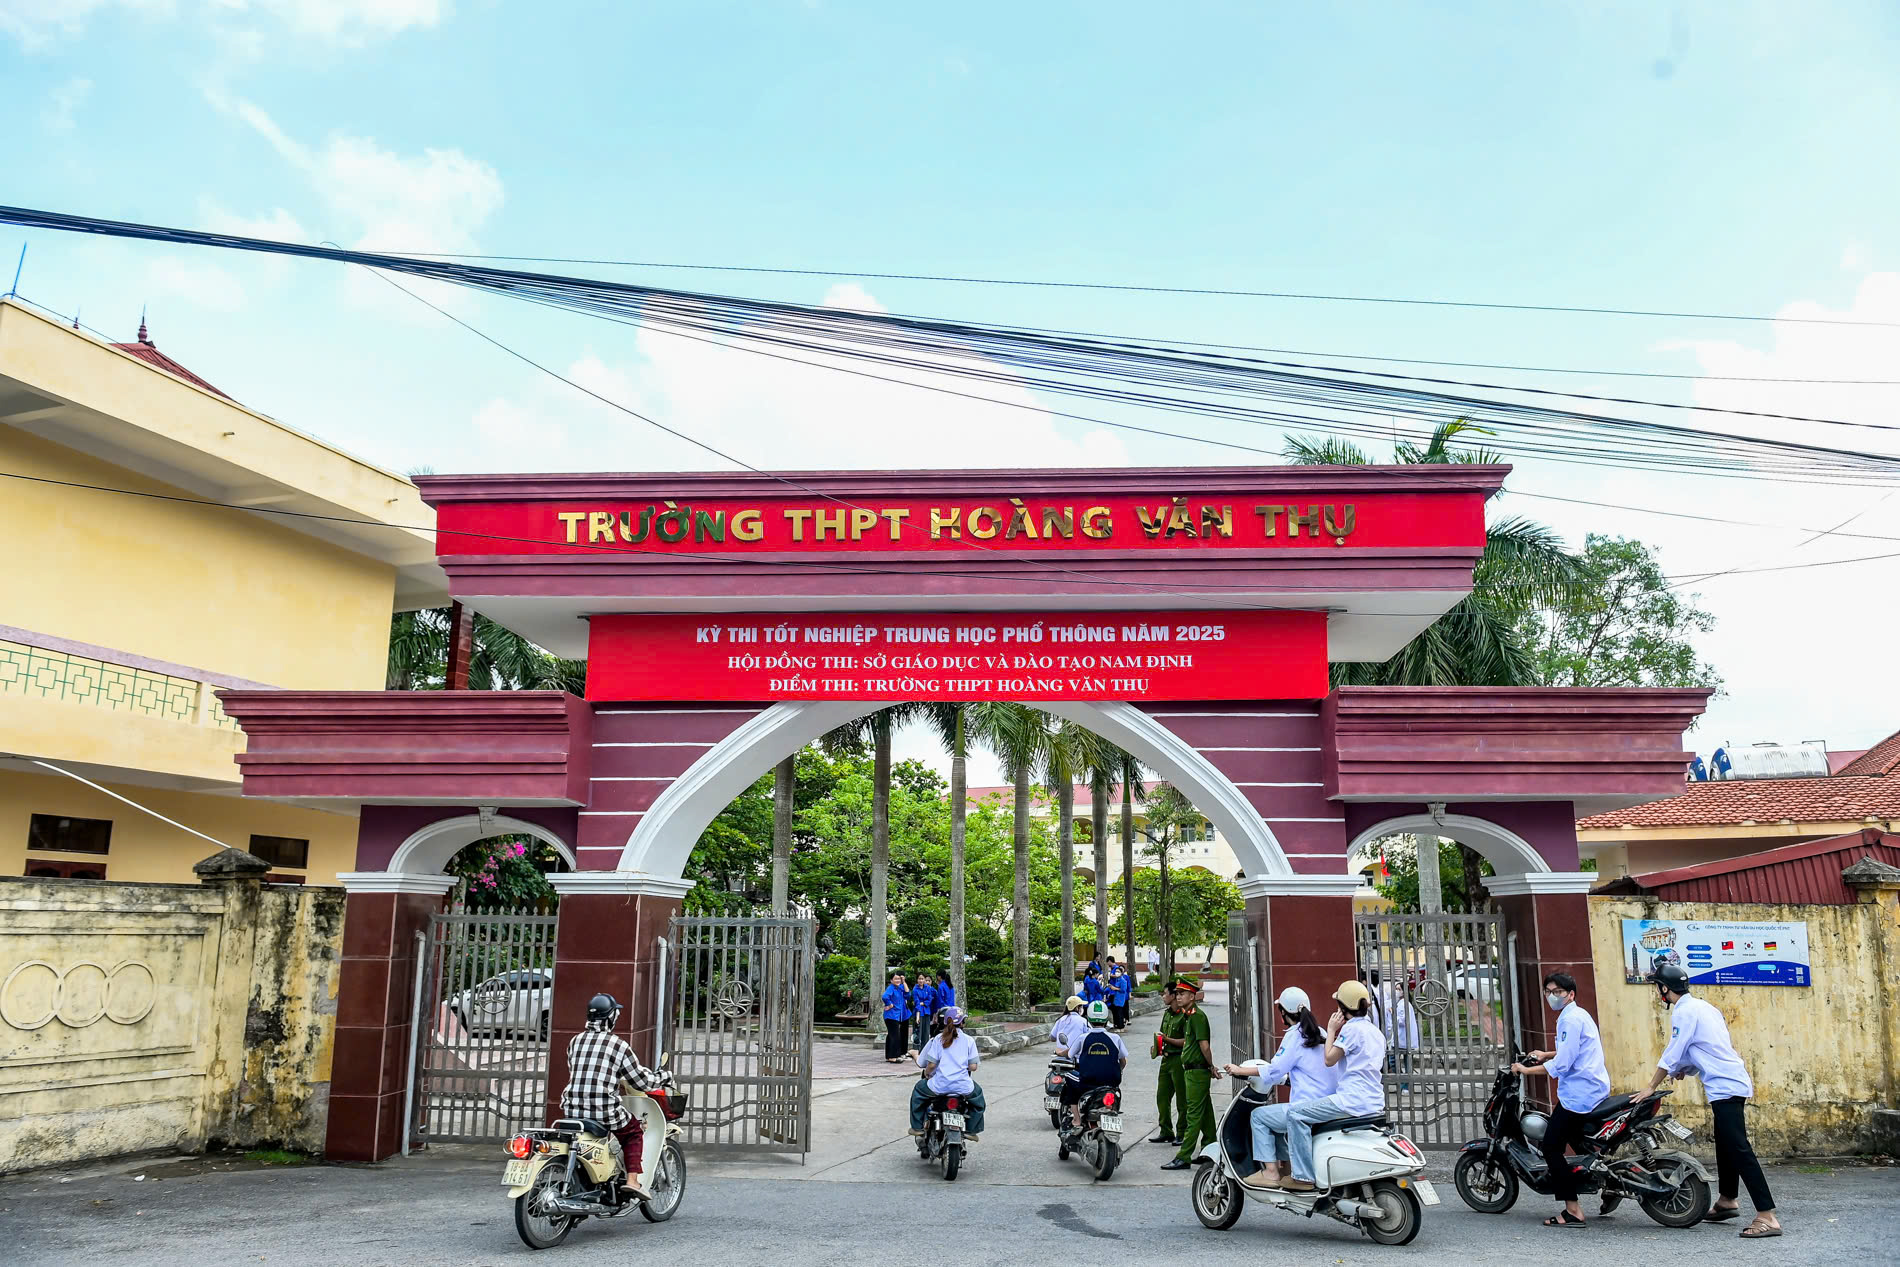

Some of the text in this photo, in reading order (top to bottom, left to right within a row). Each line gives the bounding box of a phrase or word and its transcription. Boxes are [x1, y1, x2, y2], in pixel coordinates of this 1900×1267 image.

[558, 496, 1357, 546] TRƯỜNG THPT HOÀNG VĂN THỤ
[696, 621, 1225, 646] KỲ THI TỐT NGHIỆP TRUNG HỌC PHỔ THÔNG NĂM 2025
[728, 650, 1193, 672] HỘI ĐỒNG THI: SỞ GIÁO DỤC VÀ ĐÀO TẠO NAM ĐỊNH
[769, 673, 1150, 695] ĐIỂM THI: TRƯỜNG THPT HOÀNG VĂN THỤ
